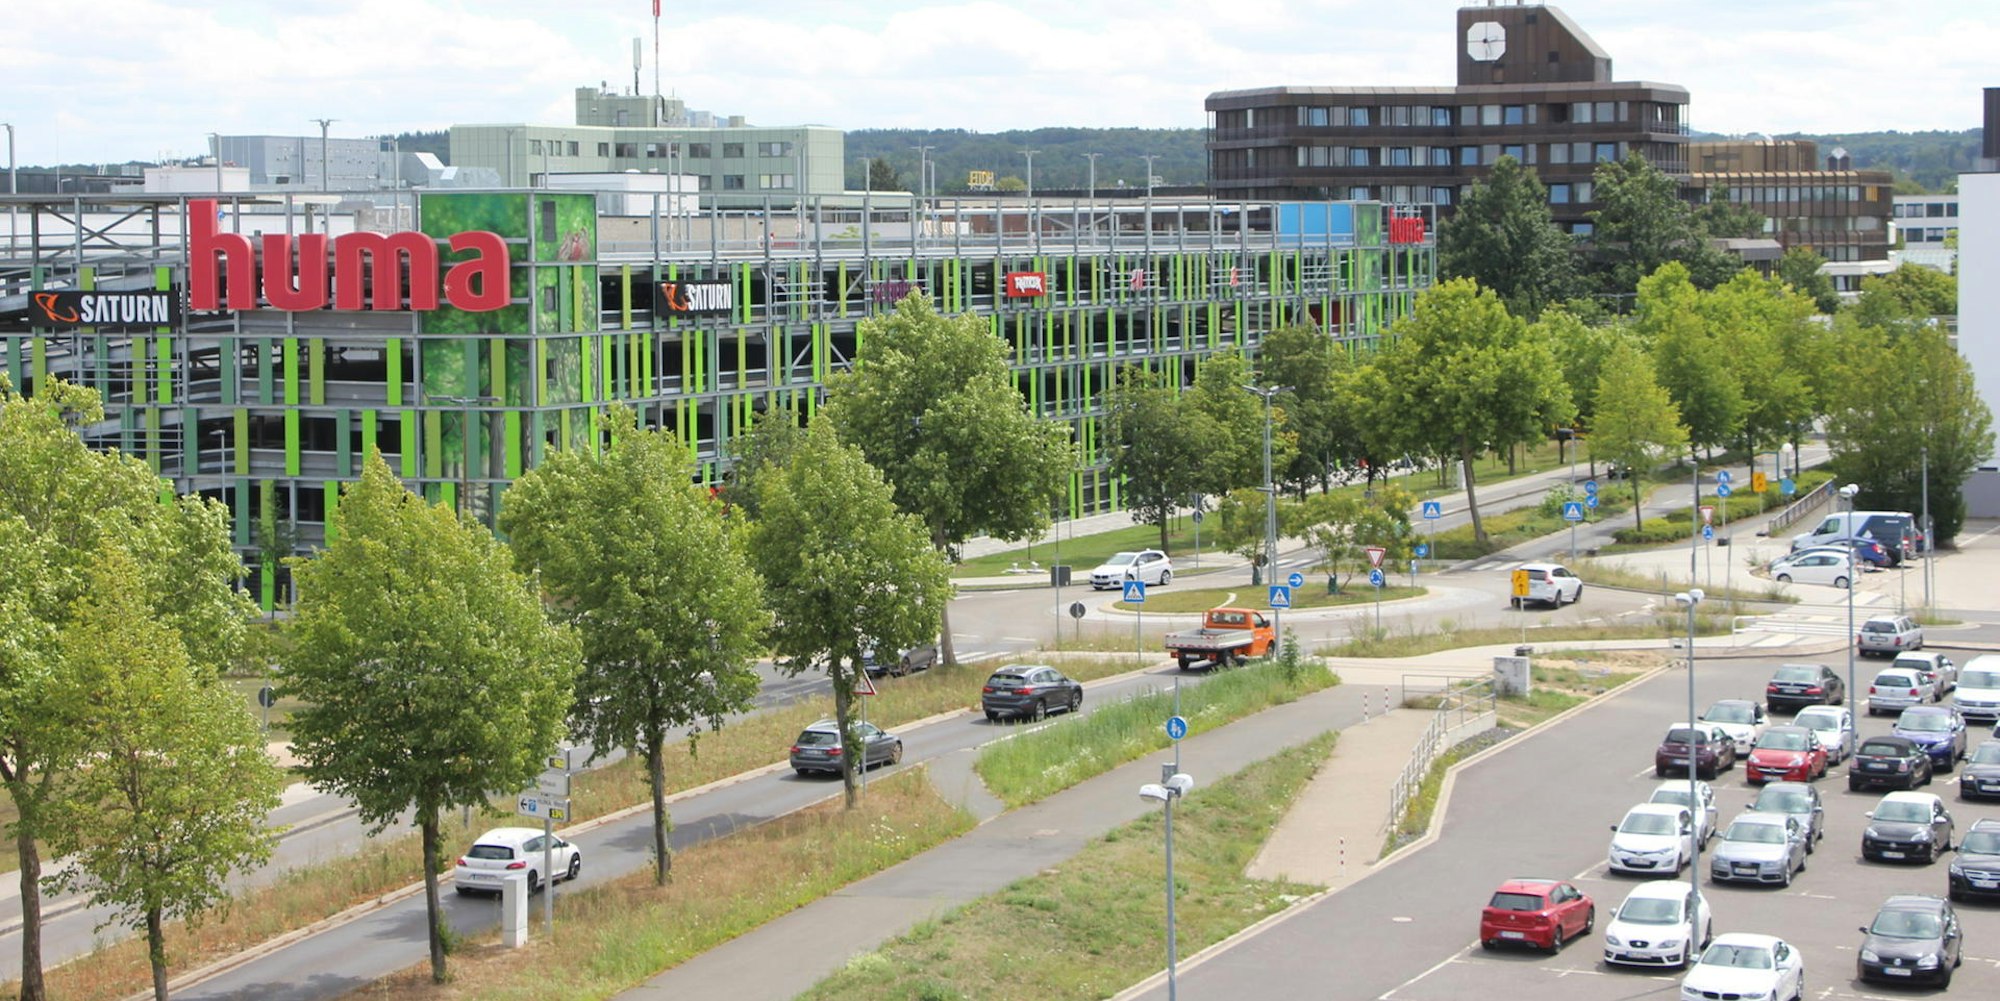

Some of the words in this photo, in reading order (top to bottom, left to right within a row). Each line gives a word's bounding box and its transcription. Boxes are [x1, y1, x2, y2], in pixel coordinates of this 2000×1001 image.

[1388, 206, 1424, 244] huma
[188, 199, 511, 312] huma
[80, 294, 169, 323] SATURN
[685, 283, 732, 311] SATURN
